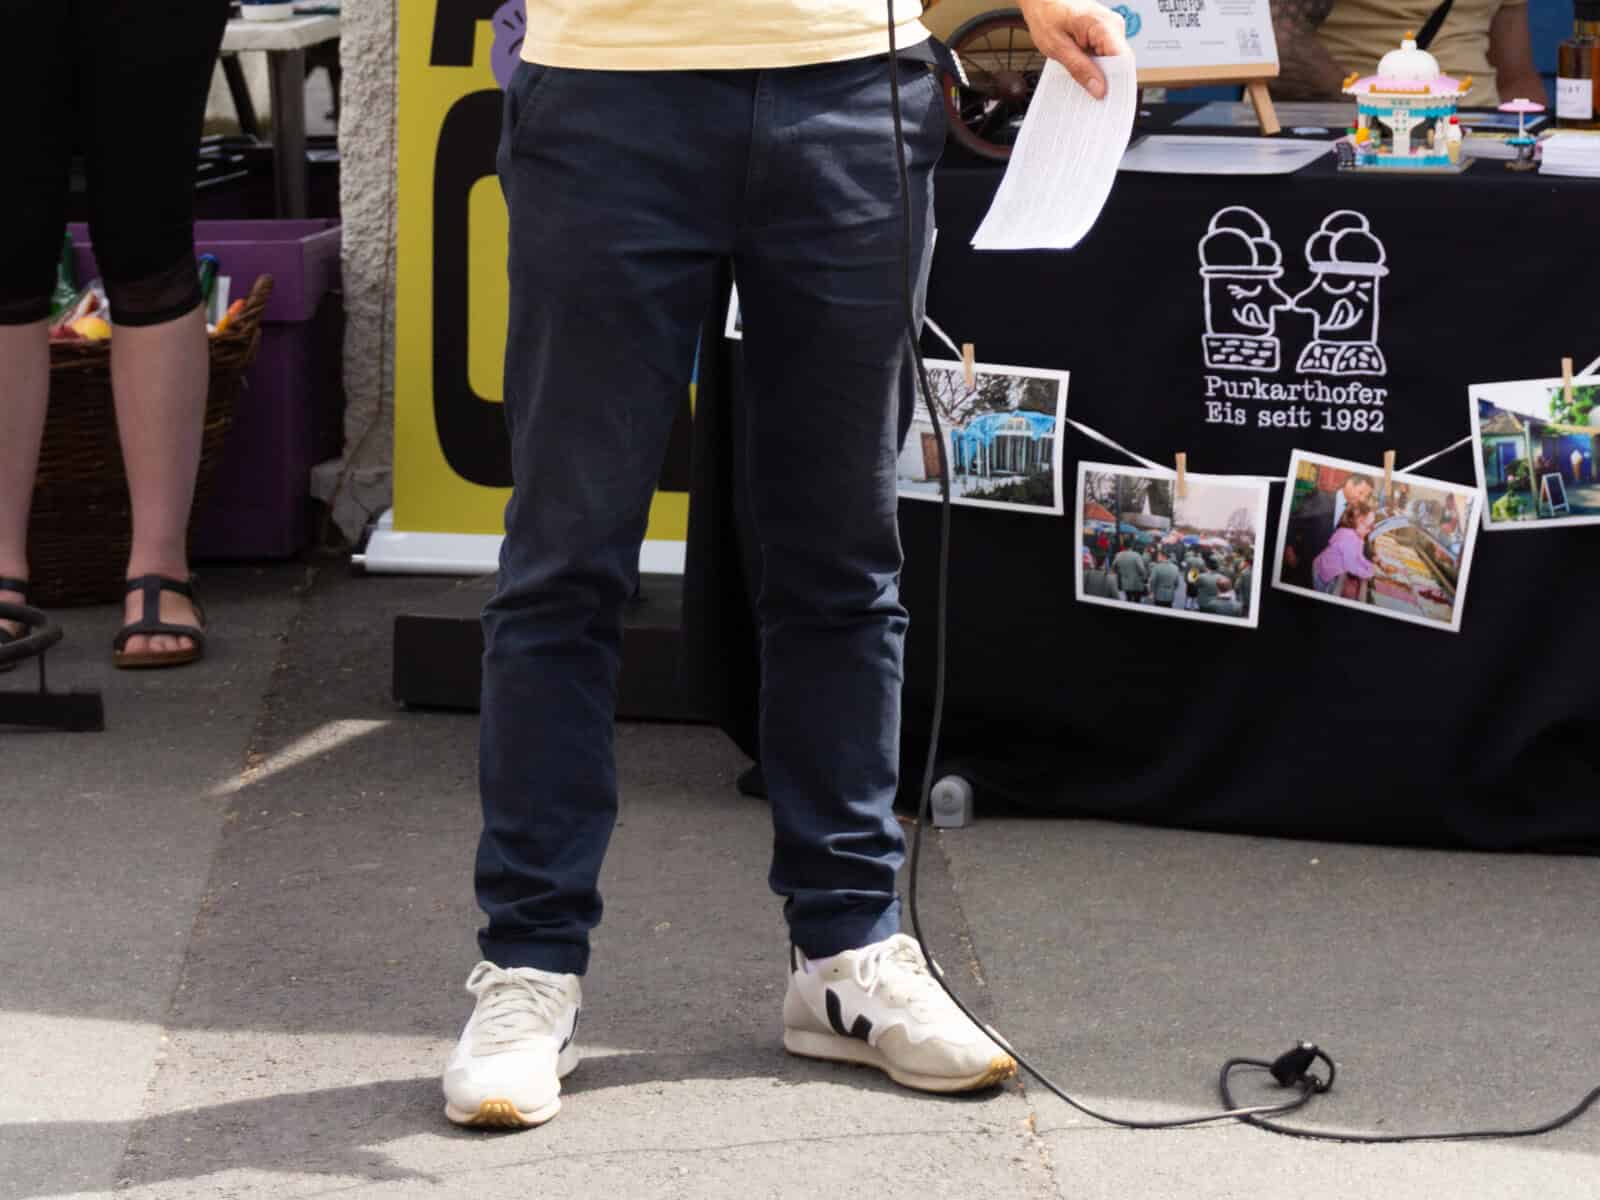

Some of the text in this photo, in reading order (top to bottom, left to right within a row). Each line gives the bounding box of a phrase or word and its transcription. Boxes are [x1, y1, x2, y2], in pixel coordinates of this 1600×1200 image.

[1168, 13, 1201, 29] FUTURE
[1204, 375, 1389, 406] Purkarthofer
[1204, 401, 1385, 433] Eis seit 1982
